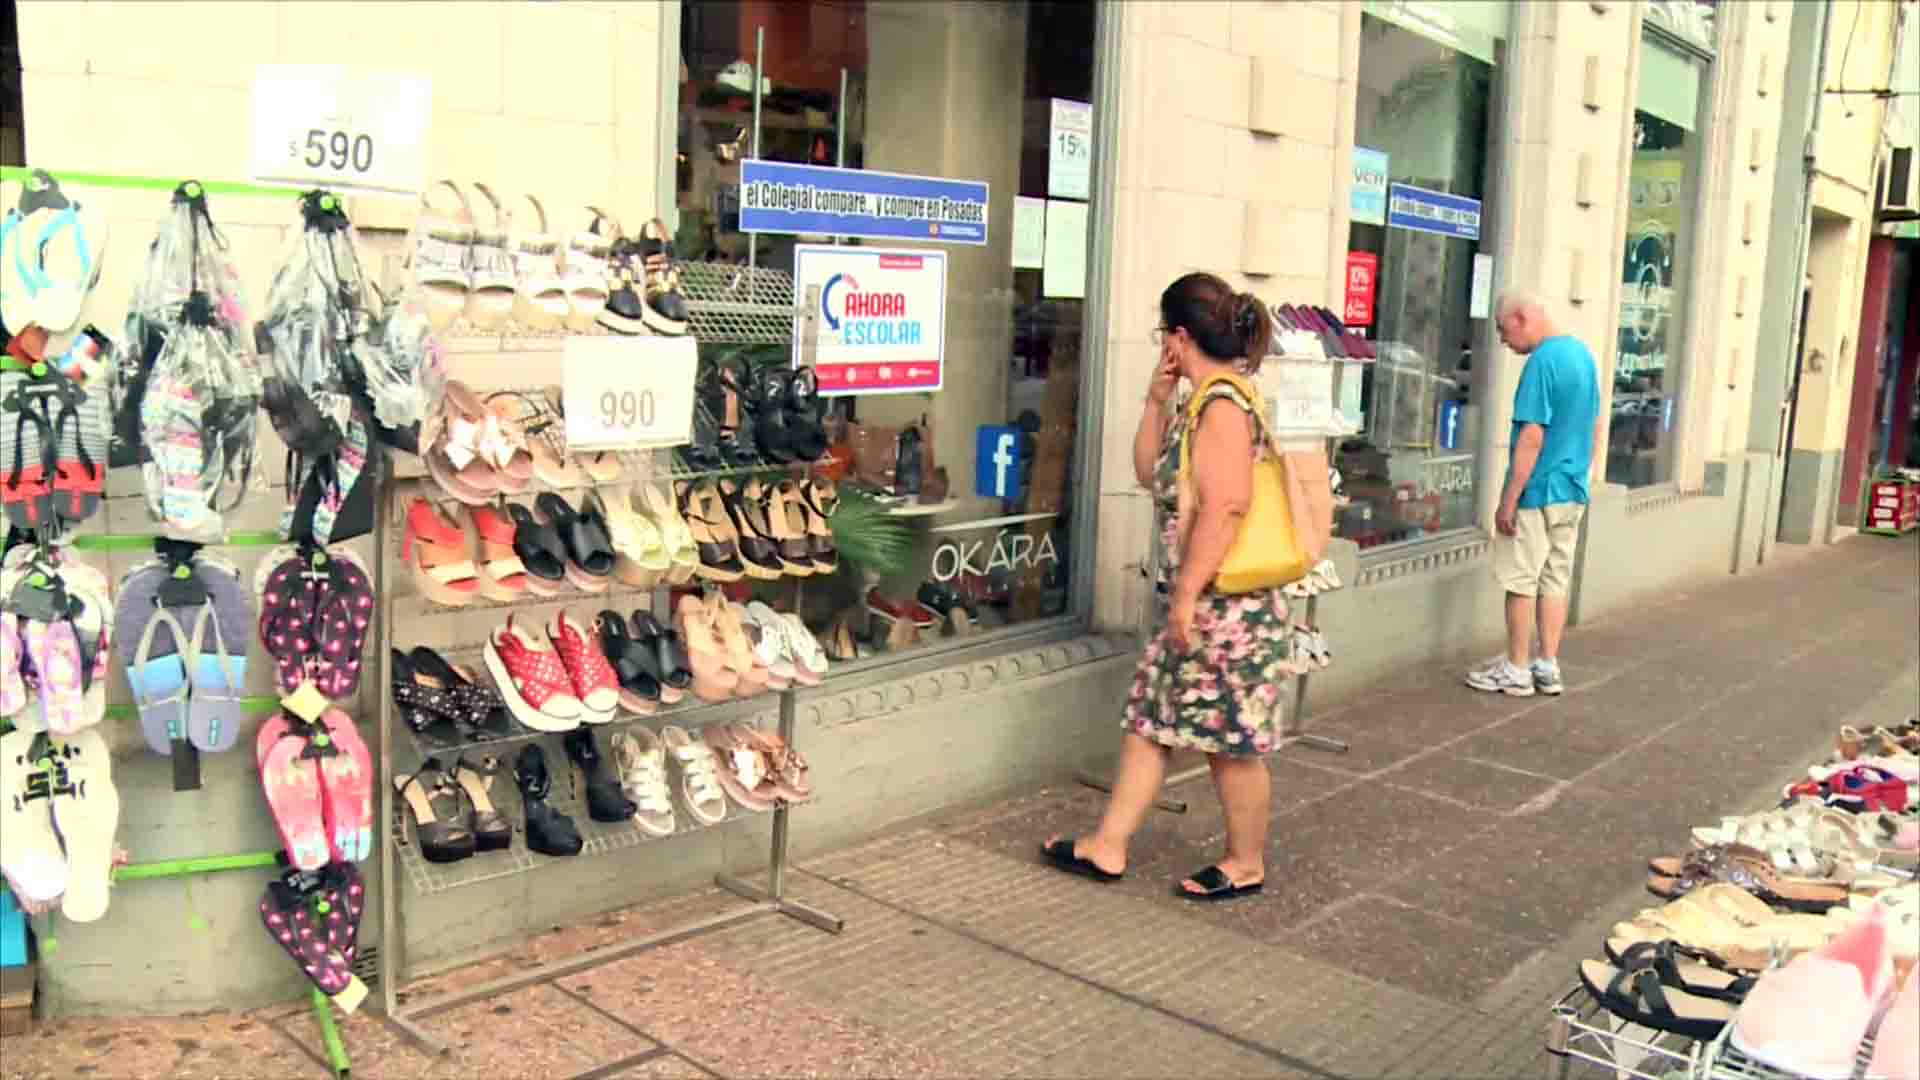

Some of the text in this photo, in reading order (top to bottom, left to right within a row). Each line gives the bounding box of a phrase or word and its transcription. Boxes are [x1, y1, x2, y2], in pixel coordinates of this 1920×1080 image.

[305, 129, 374, 172] 590
[747, 182, 759, 206] el
[761, 183, 813, 213] Colegial
[875, 199, 882, 217] y
[884, 199, 924, 219] compre
[927, 200, 941, 218] en
[942, 198, 984, 222] Posadas
[845, 292, 906, 319] AHORA
[843, 321, 921, 345] ESCOLAR
[600, 389, 656, 429] 990
[931, 528, 1059, 582] OKÁRA
